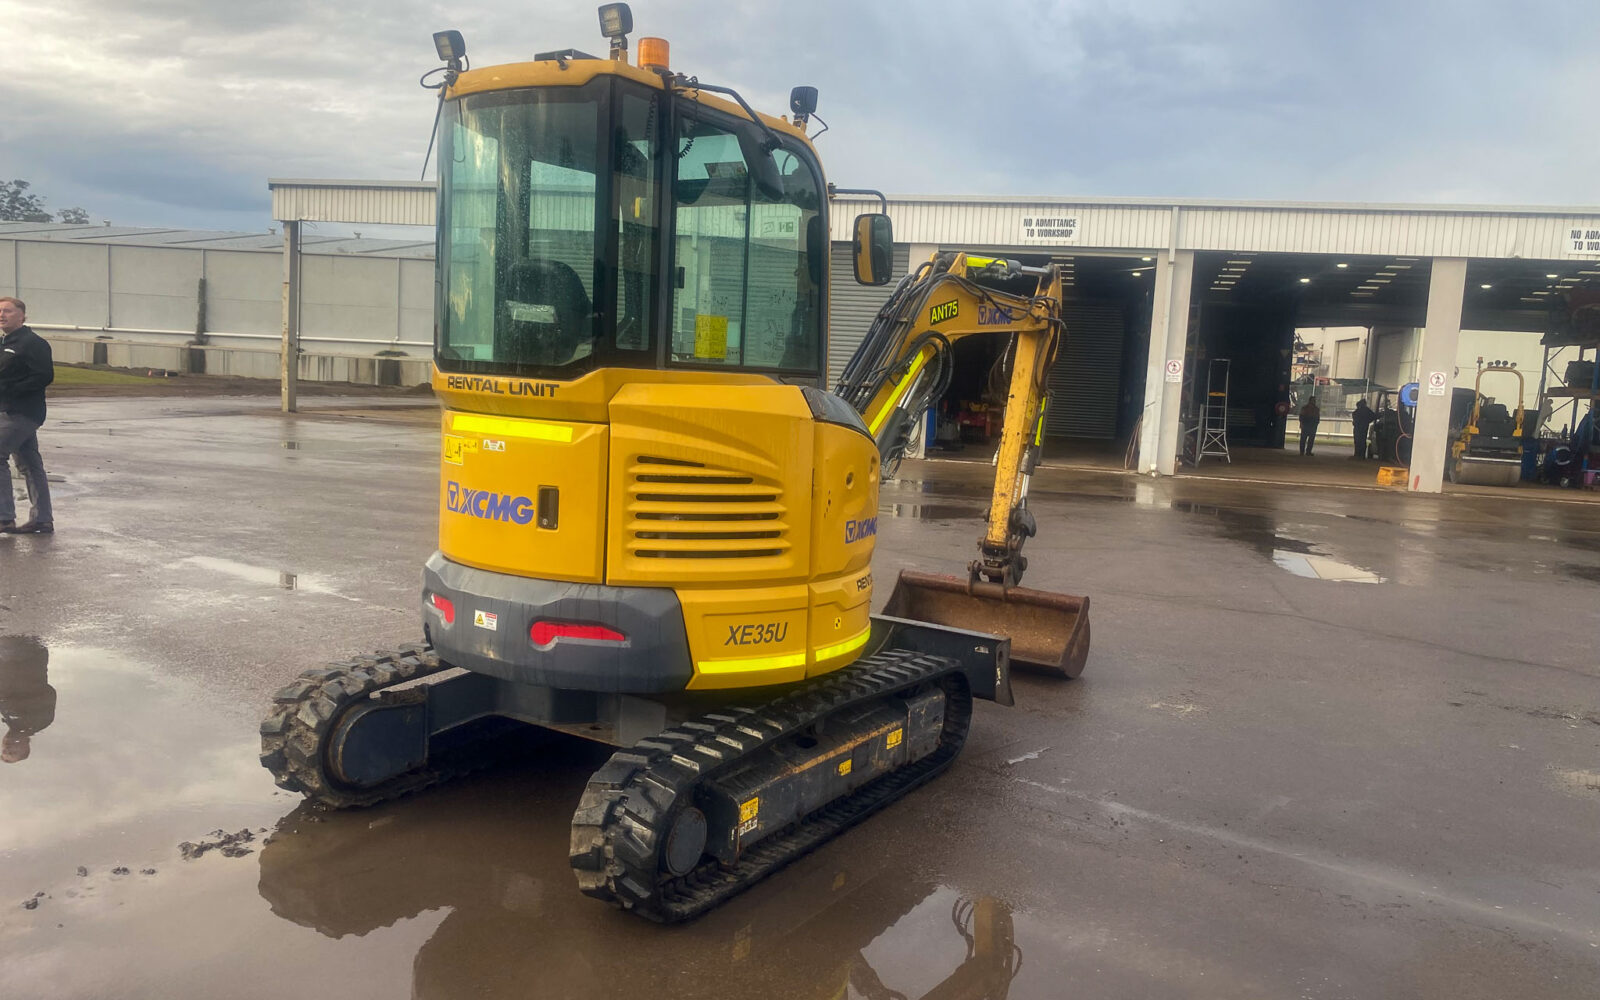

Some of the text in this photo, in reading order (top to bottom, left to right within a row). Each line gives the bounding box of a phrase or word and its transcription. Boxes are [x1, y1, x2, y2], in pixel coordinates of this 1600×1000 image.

[1023, 218, 1077, 228] NO ADMITTANCE
[1026, 228, 1073, 238] TO WORKSHOP
[1570, 230, 1582, 240] NO
[1573, 240, 1584, 251] TO
[931, 301, 958, 323] AN175
[447, 375, 560, 398] RENTAL UNIT
[459, 487, 535, 525] XCMG
[724, 621, 789, 646] XE35U
